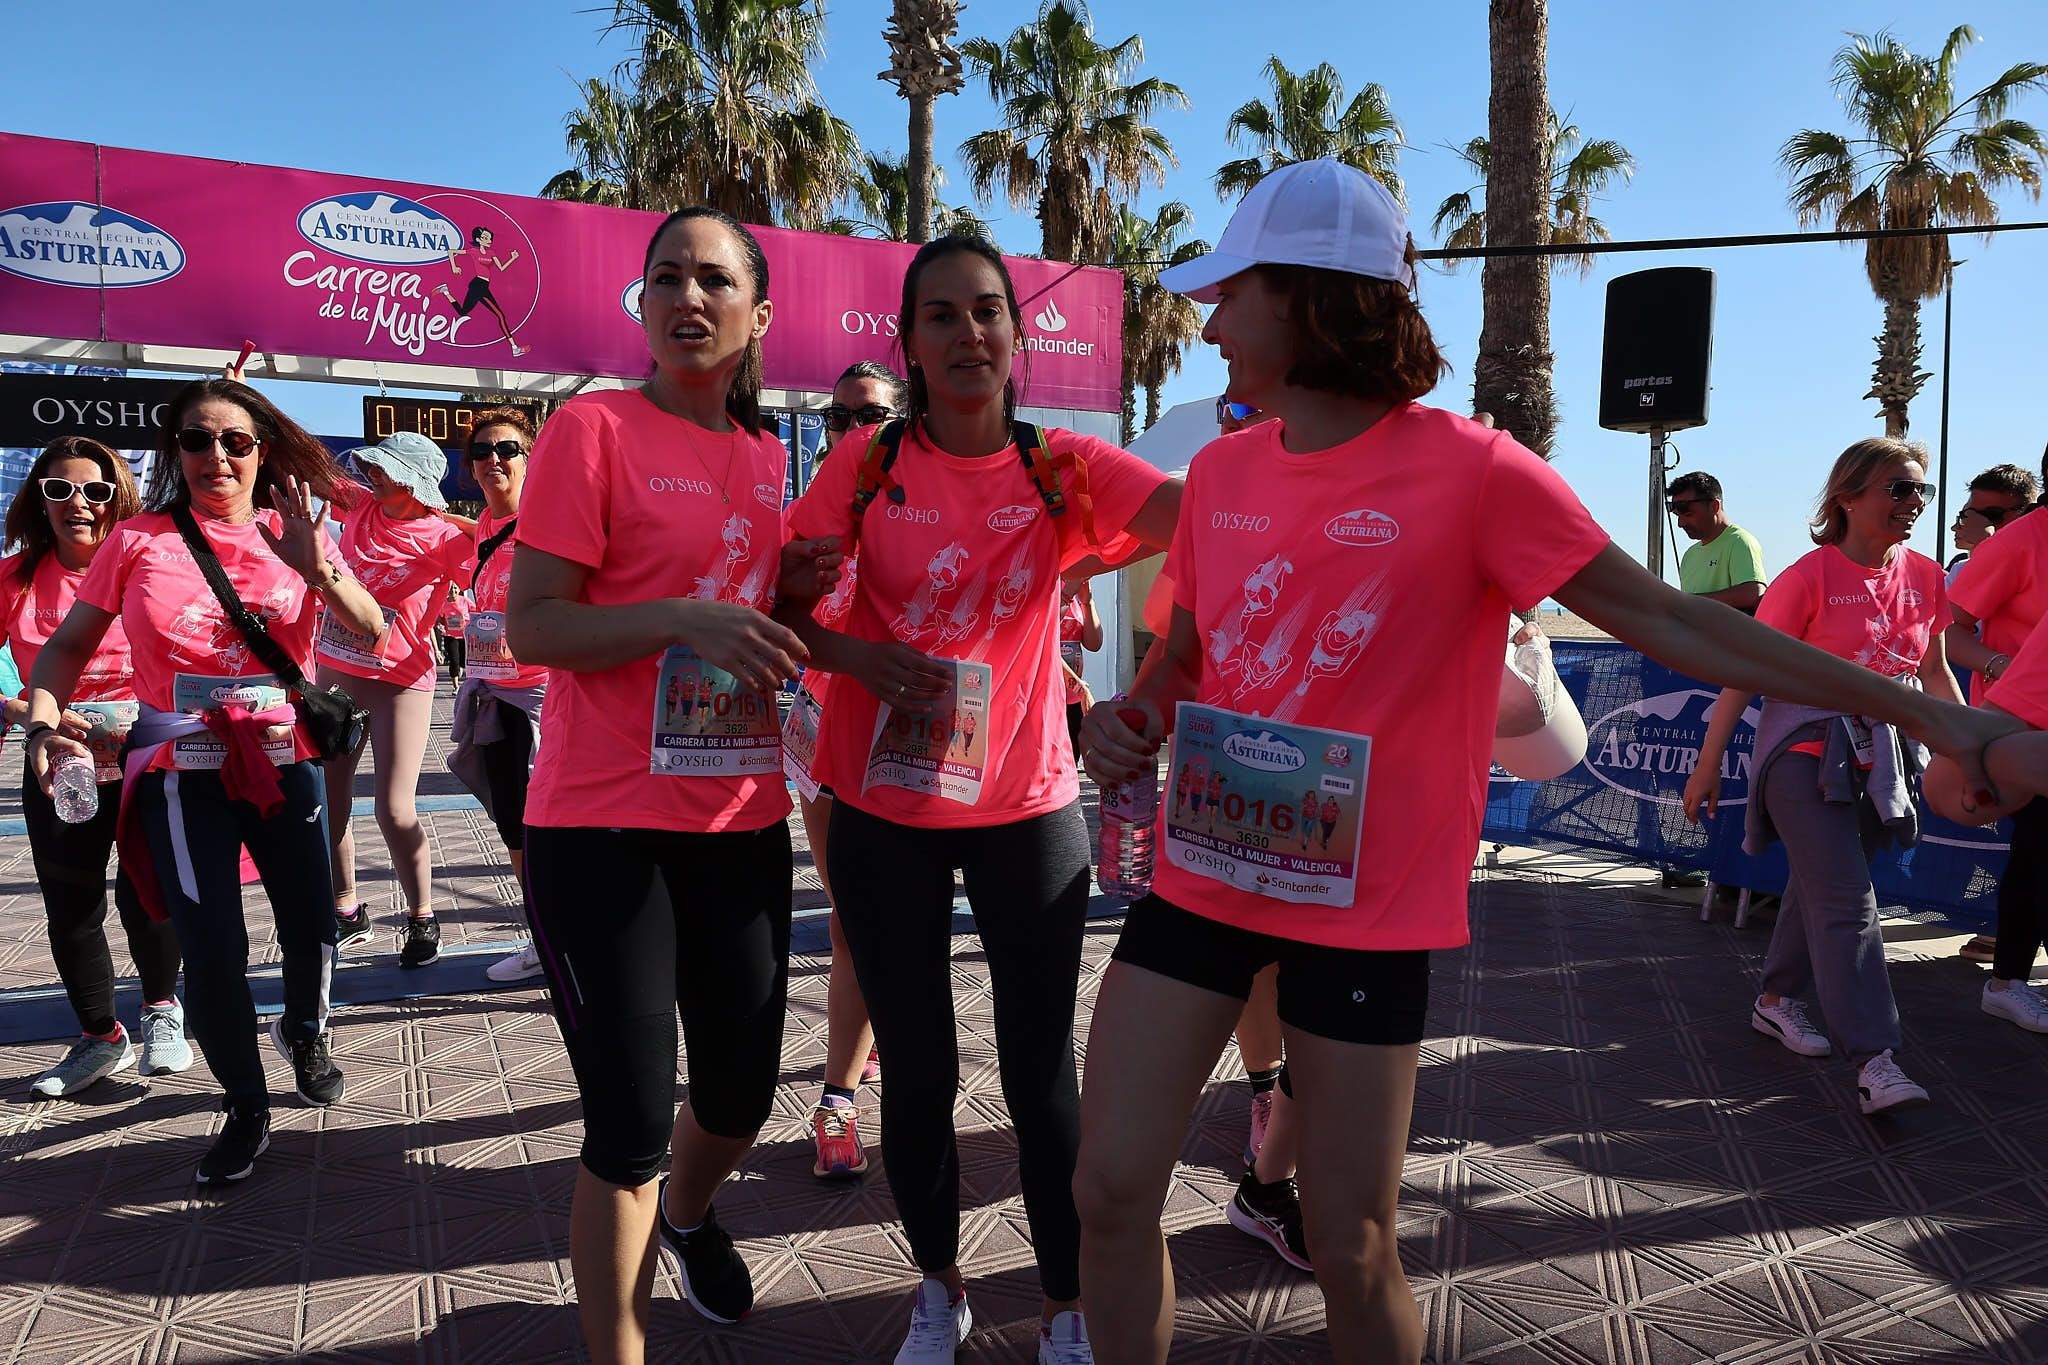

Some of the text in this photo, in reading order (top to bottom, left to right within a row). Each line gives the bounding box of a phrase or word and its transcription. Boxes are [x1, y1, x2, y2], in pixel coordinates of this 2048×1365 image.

[311, 211, 450, 252] ASTURIANA
[336, 211, 448, 232] CENTRAL LECHERA
[22, 226, 89, 240] CENTRAL
[0, 225, 170, 271] ASTURIANA
[283, 250, 422, 298] Carrera
[319, 293, 471, 356] de la Mujer
[841, 310, 898, 337] OYS
[1020, 335, 1095, 356] ntander
[650, 477, 712, 495] OYSHO
[1212, 511, 1271, 532] OYSHO
[1329, 520, 1393, 539] ASTURIANA
[1829, 594, 1870, 605] OYSHO
[725, 723, 748, 735] 3629
[1633, 726, 1697, 741] CENTRAL
[181, 743, 211, 751] CARRERA
[261, 741, 288, 750] VALENCIA
[663, 736, 705, 747] CARRERA
[708, 738, 718, 747] DE
[721, 738, 731, 747] LA
[733, 737, 755, 747] MUJER
[1227, 737, 1299, 767] ASTURIANA
[1327, 744, 1348, 759] 20
[671, 755, 723, 767] OYSHO
[1594, 726, 1752, 780] ASTURAN
[893, 753, 902, 763] DE
[903, 755, 912, 764] LA
[912, 757, 937, 769] MUJER
[943, 763, 976, 778] VALENCIA
[930, 779, 969, 794] Santander
[1236, 831, 1269, 849] 3630
[1175, 828, 1216, 849] CARRERA
[1217, 841, 1230, 853] DE
[1231, 845, 1243, 857] LA
[1246, 848, 1280, 866] MUJER
[1291, 858, 1342, 874] VALENCIA
[1184, 848, 1331, 895] OYSHO Santander
